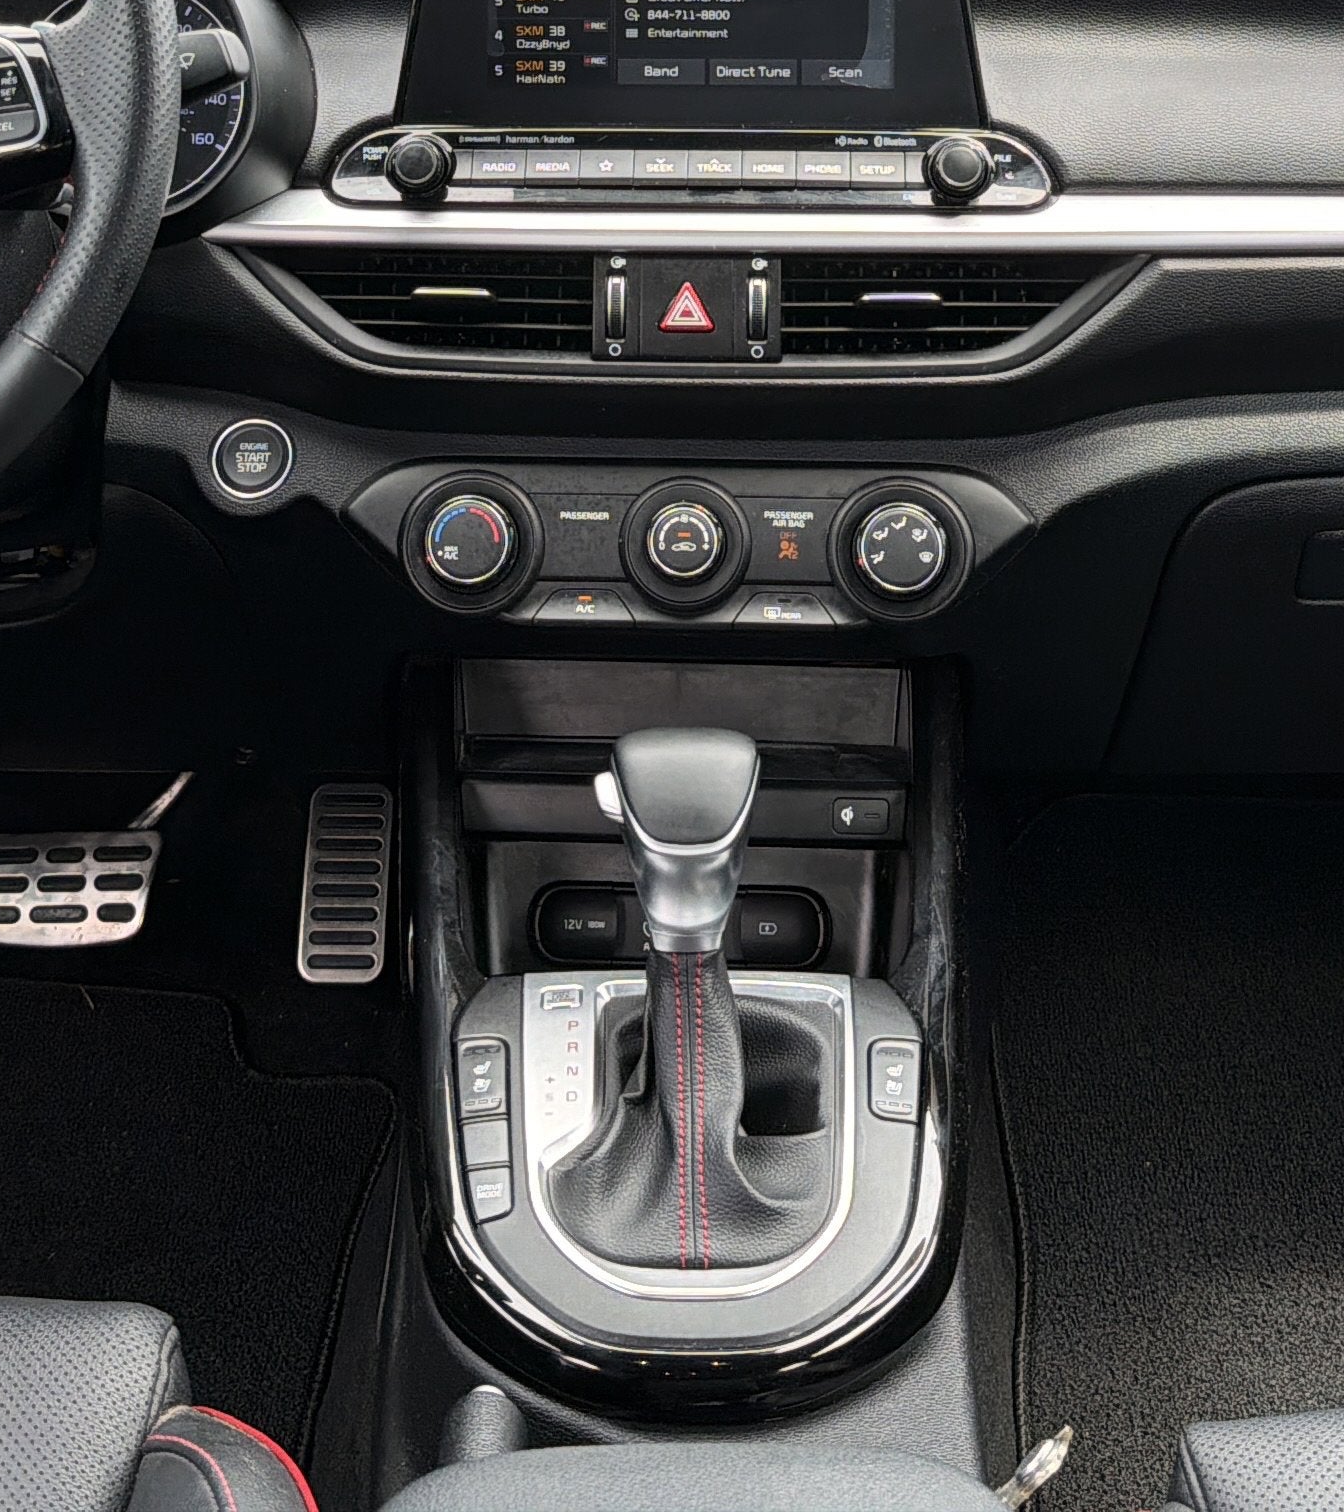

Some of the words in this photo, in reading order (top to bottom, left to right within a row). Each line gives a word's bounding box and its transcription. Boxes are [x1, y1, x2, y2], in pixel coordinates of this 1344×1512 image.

[516, 4, 549, 14] Turbo
[494, 29, 503, 41] 4
[515, 25, 544, 37] SXM
[647, 28, 729, 39] Entertainment
[494, 65, 503, 76] 5
[515, 60, 544, 72] SXM
[548, 60, 566, 72] 39
[644, 65, 679, 77] Band
[716, 66, 756, 77] Direct
[758, 66, 791, 77] Tune
[828, 66, 863, 78] Scan
[191, 133, 215, 145] 160
[482, 162, 517, 172] RADIO
[535, 162, 571, 172] MEDIA
[645, 163, 675, 173] SEEK
[696, 163, 732, 173] TRACK
[752, 164, 785, 174] HOME
[804, 164, 842, 174] PHONE
[859, 165, 896, 175] SETUP
[239, 442, 269, 451] ENGINE
[235, 451, 272, 463] START
[237, 462, 268, 473] STOP
[559, 510, 610, 521] PASSENGER
[763, 510, 814, 520] PASSENGER
[772, 519, 787, 528] AIR
[788, 519, 806, 528] BAG
[779, 531, 798, 540] OFF
[443, 552, 459, 560] A/C
[575, 604, 596, 614] A/C
[563, 919, 584, 930] 12V
[567, 1020, 580, 1031] P
[567, 1041, 579, 1053] R
[566, 1065, 579, 1076] N
[565, 1090, 578, 1102] D
[476, 1182, 504, 1192] DRIVE
[476, 1191, 503, 1200] MODE
